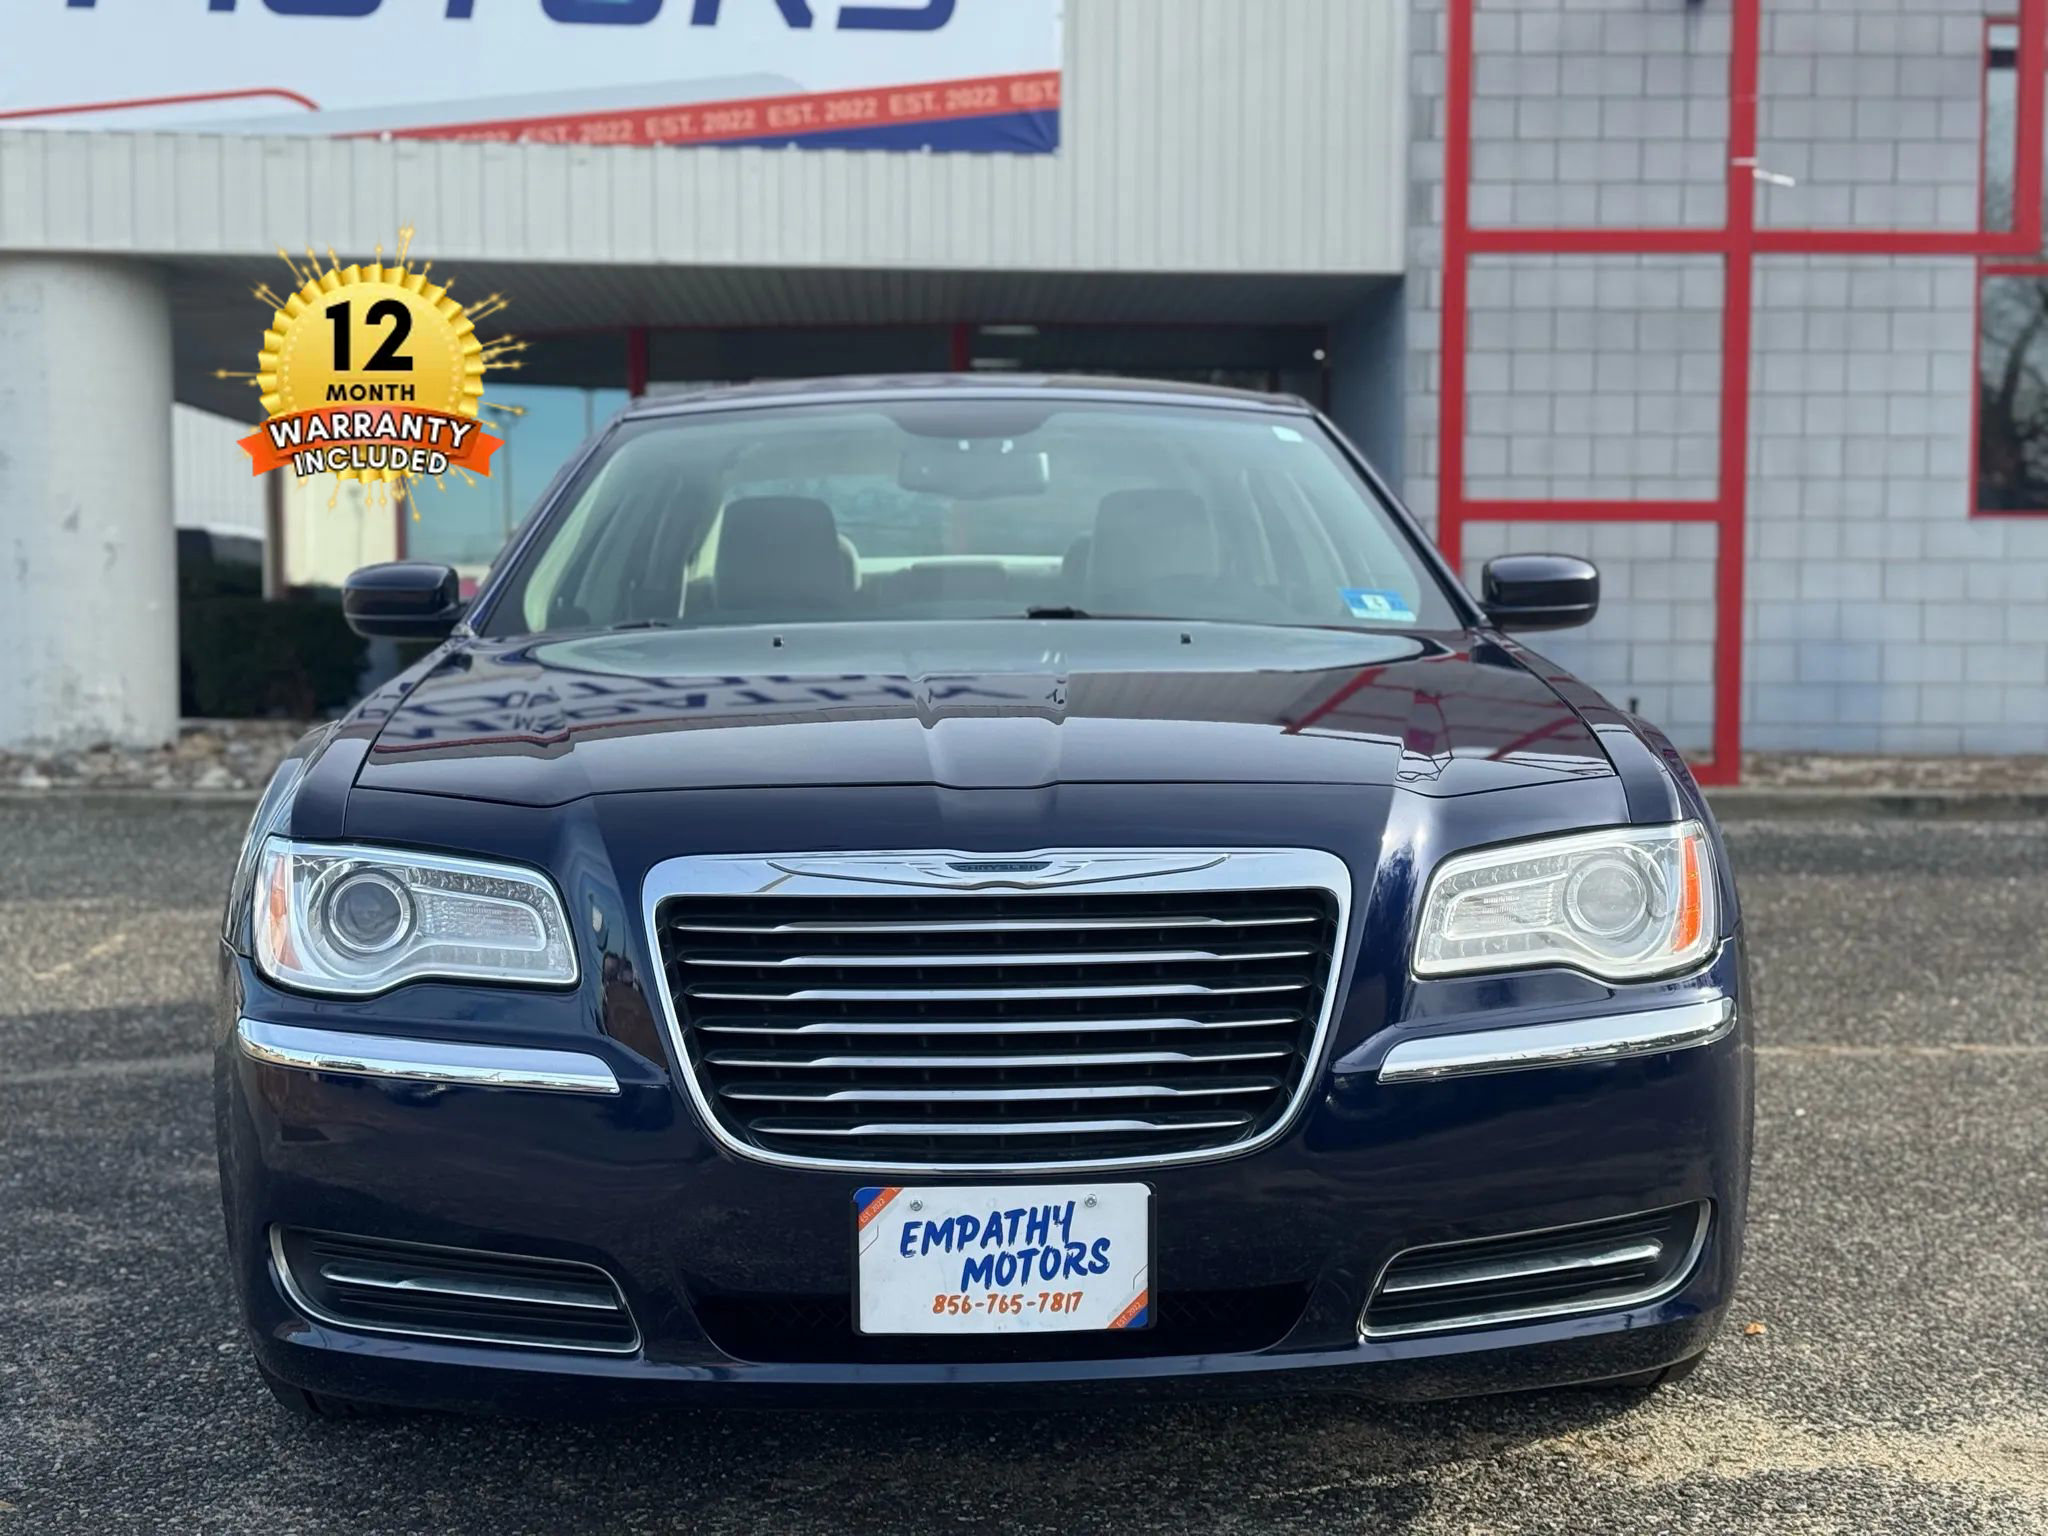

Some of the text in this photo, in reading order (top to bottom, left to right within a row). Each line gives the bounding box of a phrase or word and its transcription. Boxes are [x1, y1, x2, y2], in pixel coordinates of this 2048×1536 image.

[644, 113, 697, 138] EST.
[702, 107, 757, 134] 2022
[766, 102, 820, 128] EST.
[824, 97, 878, 122] 2022
[888, 91, 941, 116] EST.
[945, 85, 998, 111] 2022
[900, 1201, 1076, 1258] EMPATHY
[960, 1237, 1111, 1293] MOTORS
[932, 1291, 1084, 1315] 856-765-7817
